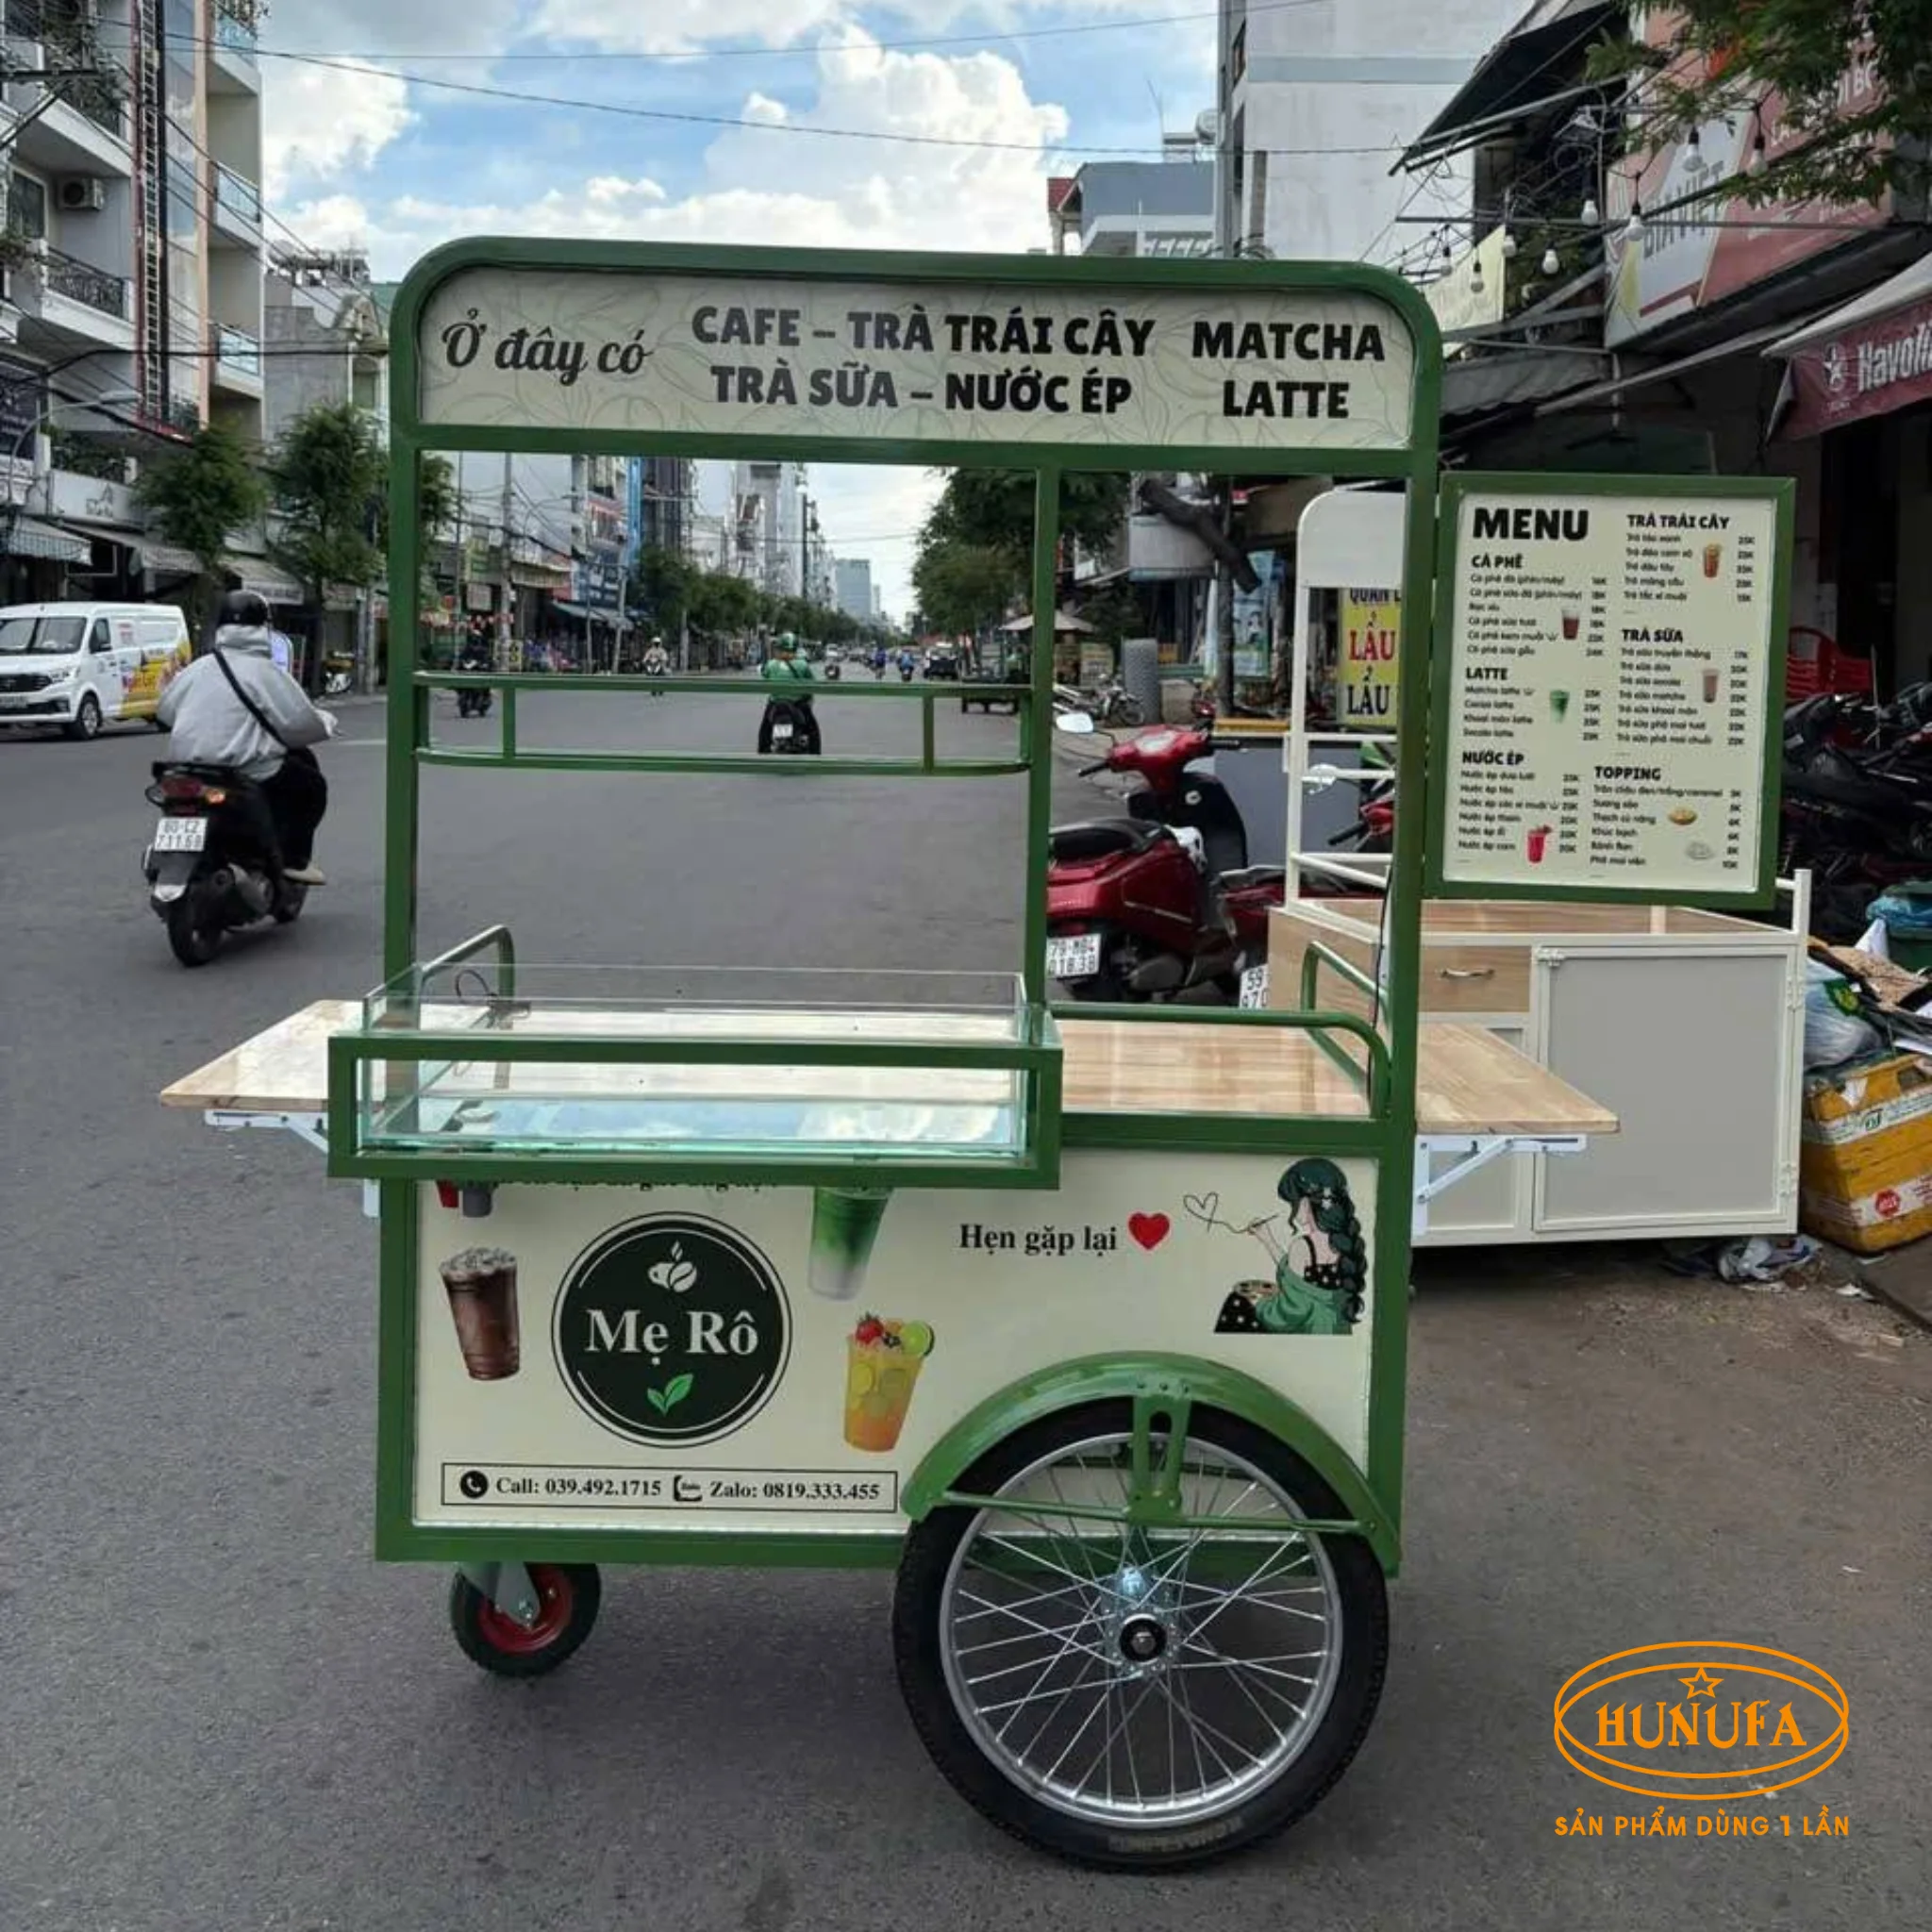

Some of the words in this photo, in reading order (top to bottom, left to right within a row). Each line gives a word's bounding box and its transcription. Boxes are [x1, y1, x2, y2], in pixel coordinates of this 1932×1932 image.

[441, 308, 488, 368] Ở
[494, 326, 588, 386] đây
[598, 329, 653, 374] có
[692, 306, 800, 346] CAFE
[848, 304, 934, 353] TRÀ
[944, 306, 1053, 356] TRÁI
[1064, 308, 1156, 357] CÂY
[1191, 321, 1385, 361] MATCHA
[709, 358, 797, 406] TRÀ
[808, 361, 898, 408] SỮA
[945, 366, 1069, 413] NƯỚC
[1081, 367, 1132, 414] ÉP
[1223, 379, 1350, 419] LATTE
[1473, 507, 1589, 541] MENU
[1626, 512, 1657, 527] TRÀ
[1660, 512, 1696, 528] TRÁI
[1699, 513, 1729, 529] CÂY
[1471, 552, 1491, 568] CÀ
[1495, 553, 1524, 569] PHÊ
[1349, 611, 1395, 660] LẨU
[1622, 627, 1650, 642] TRÀ
[1654, 627, 1683, 643] SỮA
[1466, 667, 1508, 680] LATTE
[1348, 665, 1390, 716] LẨU
[1462, 750, 1504, 765] NƯỚC
[1507, 749, 1524, 765] ÉP
[1594, 766, 1661, 781] TOPPING
[960, 1224, 1015, 1256] Hẹn
[1024, 1226, 1074, 1256] gặp
[1084, 1226, 1116, 1257] lại
[584, 1308, 669, 1366] Mẹ
[686, 1310, 758, 1356] Rô
[496, 1476, 539, 1495] Call:
[545, 1477, 661, 1497] 039.492.1715
[709, 1480, 758, 1499] Zalo:
[762, 1481, 880, 1502] 0819.333.455
